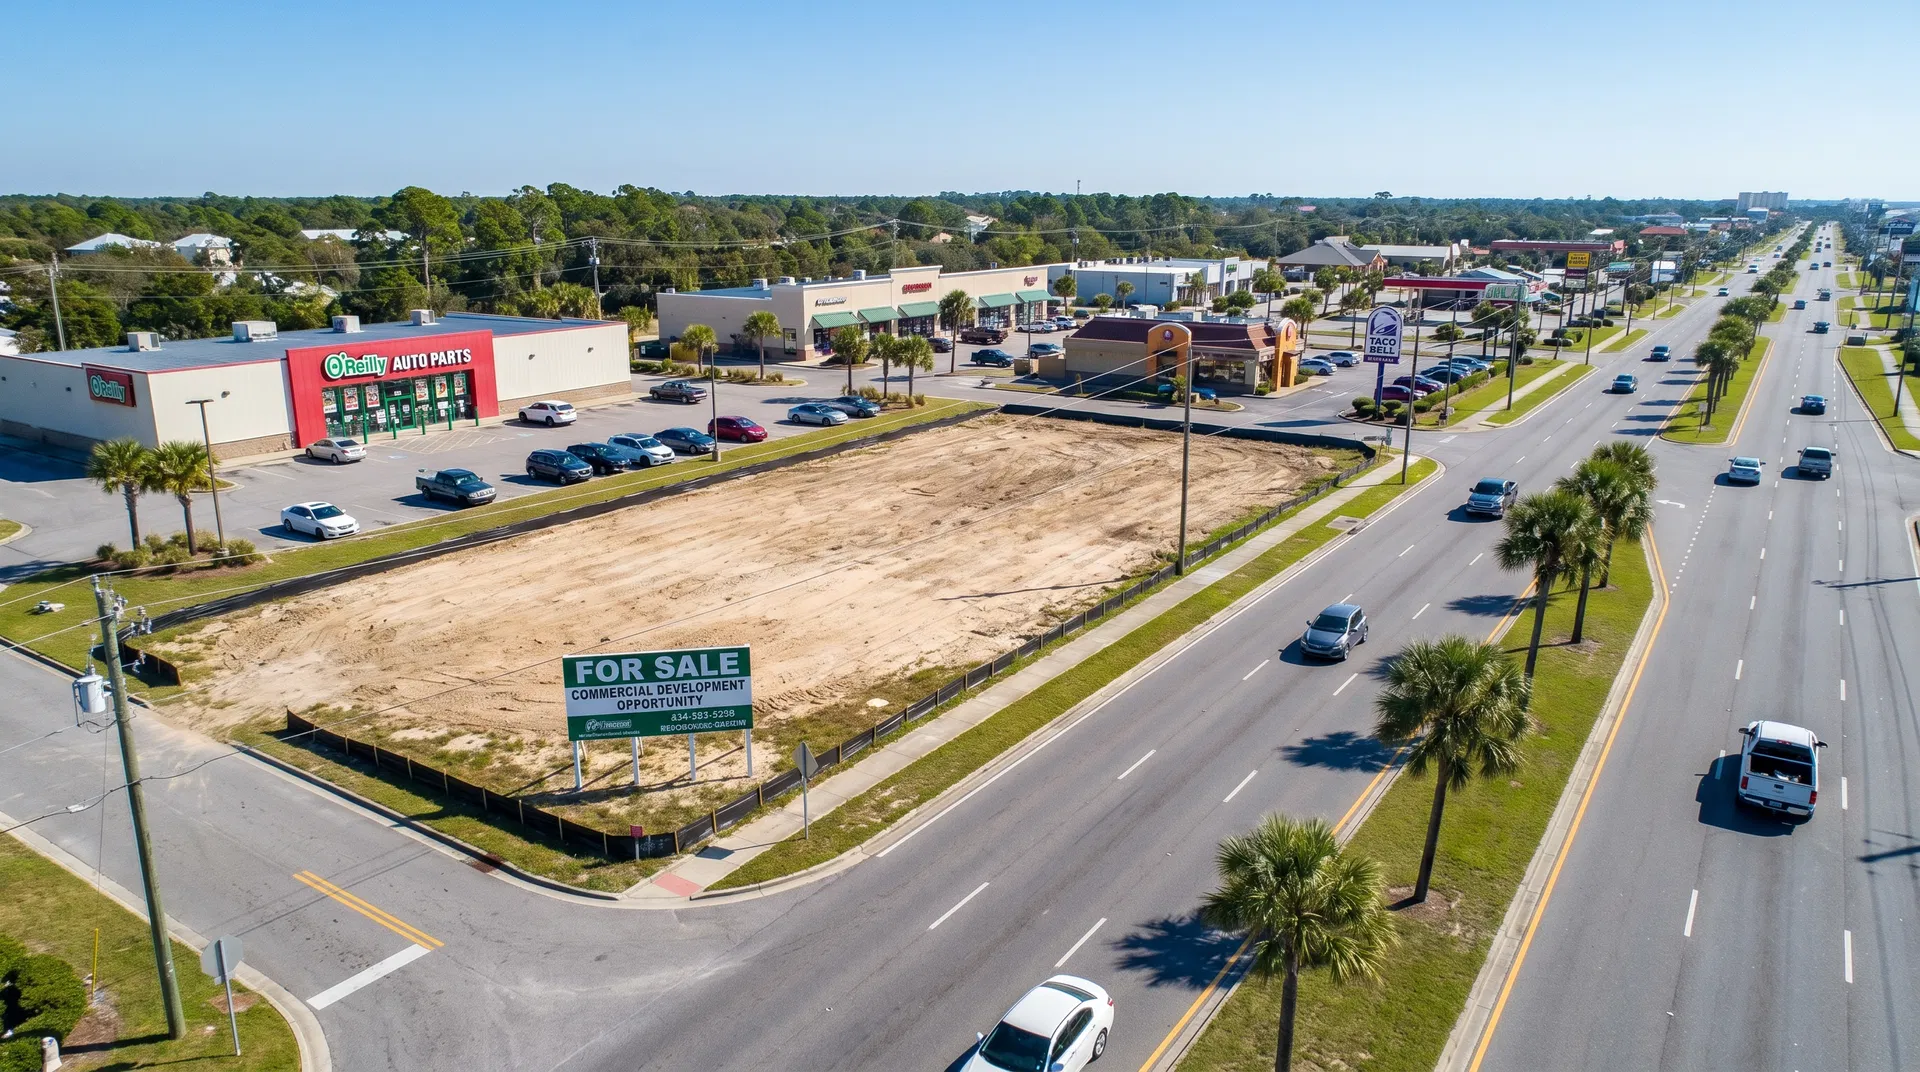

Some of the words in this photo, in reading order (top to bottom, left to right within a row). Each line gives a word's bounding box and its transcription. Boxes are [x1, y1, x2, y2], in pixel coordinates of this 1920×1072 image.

[1369, 337, 1397, 346] TACO
[1369, 346, 1395, 355] BELL
[325, 352, 387, 378] O'Reilly
[393, 354, 428, 371] AUTO
[430, 348, 472, 366] PARTS
[575, 658, 645, 684] FOR
[654, 652, 740, 679] SALE
[571, 685, 654, 701] COMMERCIAL
[657, 679, 746, 696] DEVELOPMENT
[616, 694, 704, 711] OPPORTUNITY
